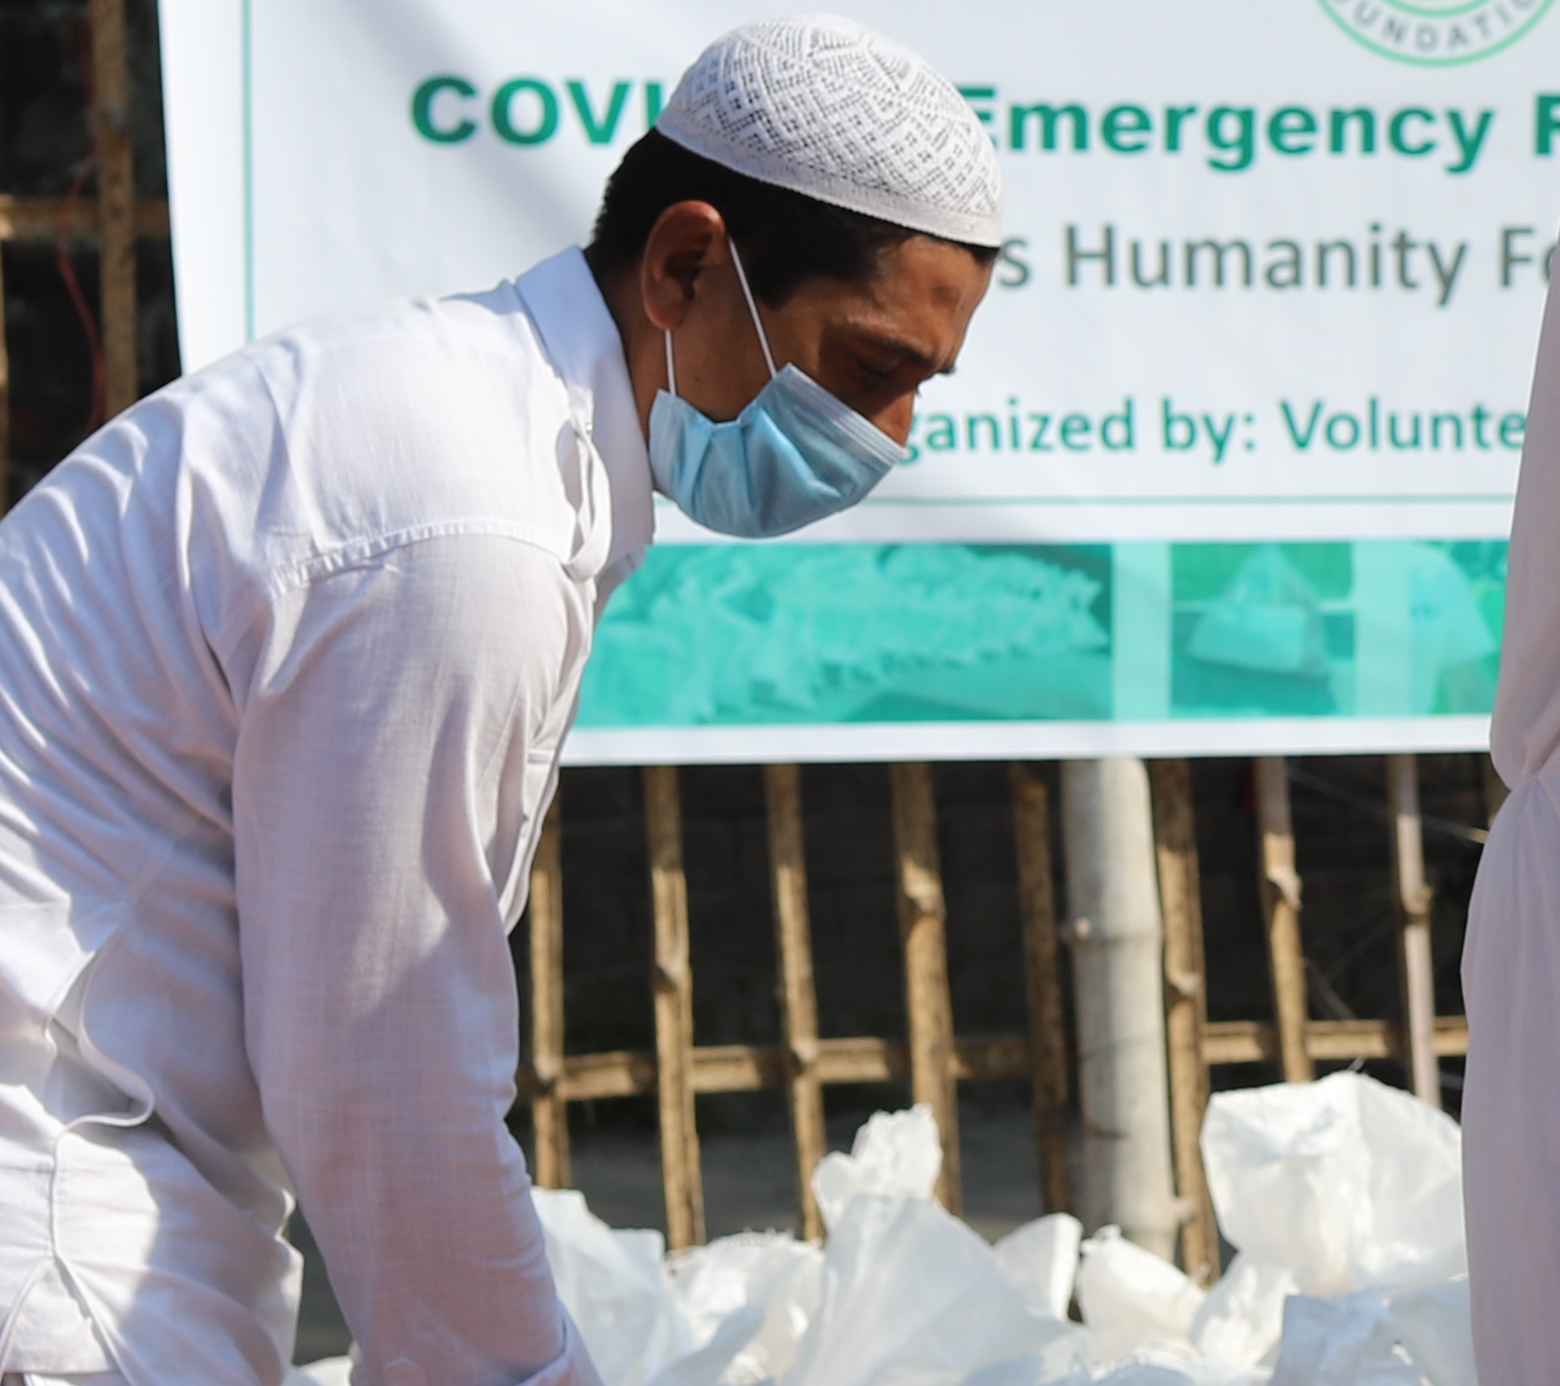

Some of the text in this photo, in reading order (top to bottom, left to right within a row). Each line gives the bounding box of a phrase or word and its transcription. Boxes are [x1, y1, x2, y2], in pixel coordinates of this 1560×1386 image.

[413, 75, 663, 145] COVI
[1064, 224, 1468, 307] Humanity
[906, 394, 1527, 465] anized by: Volunte
